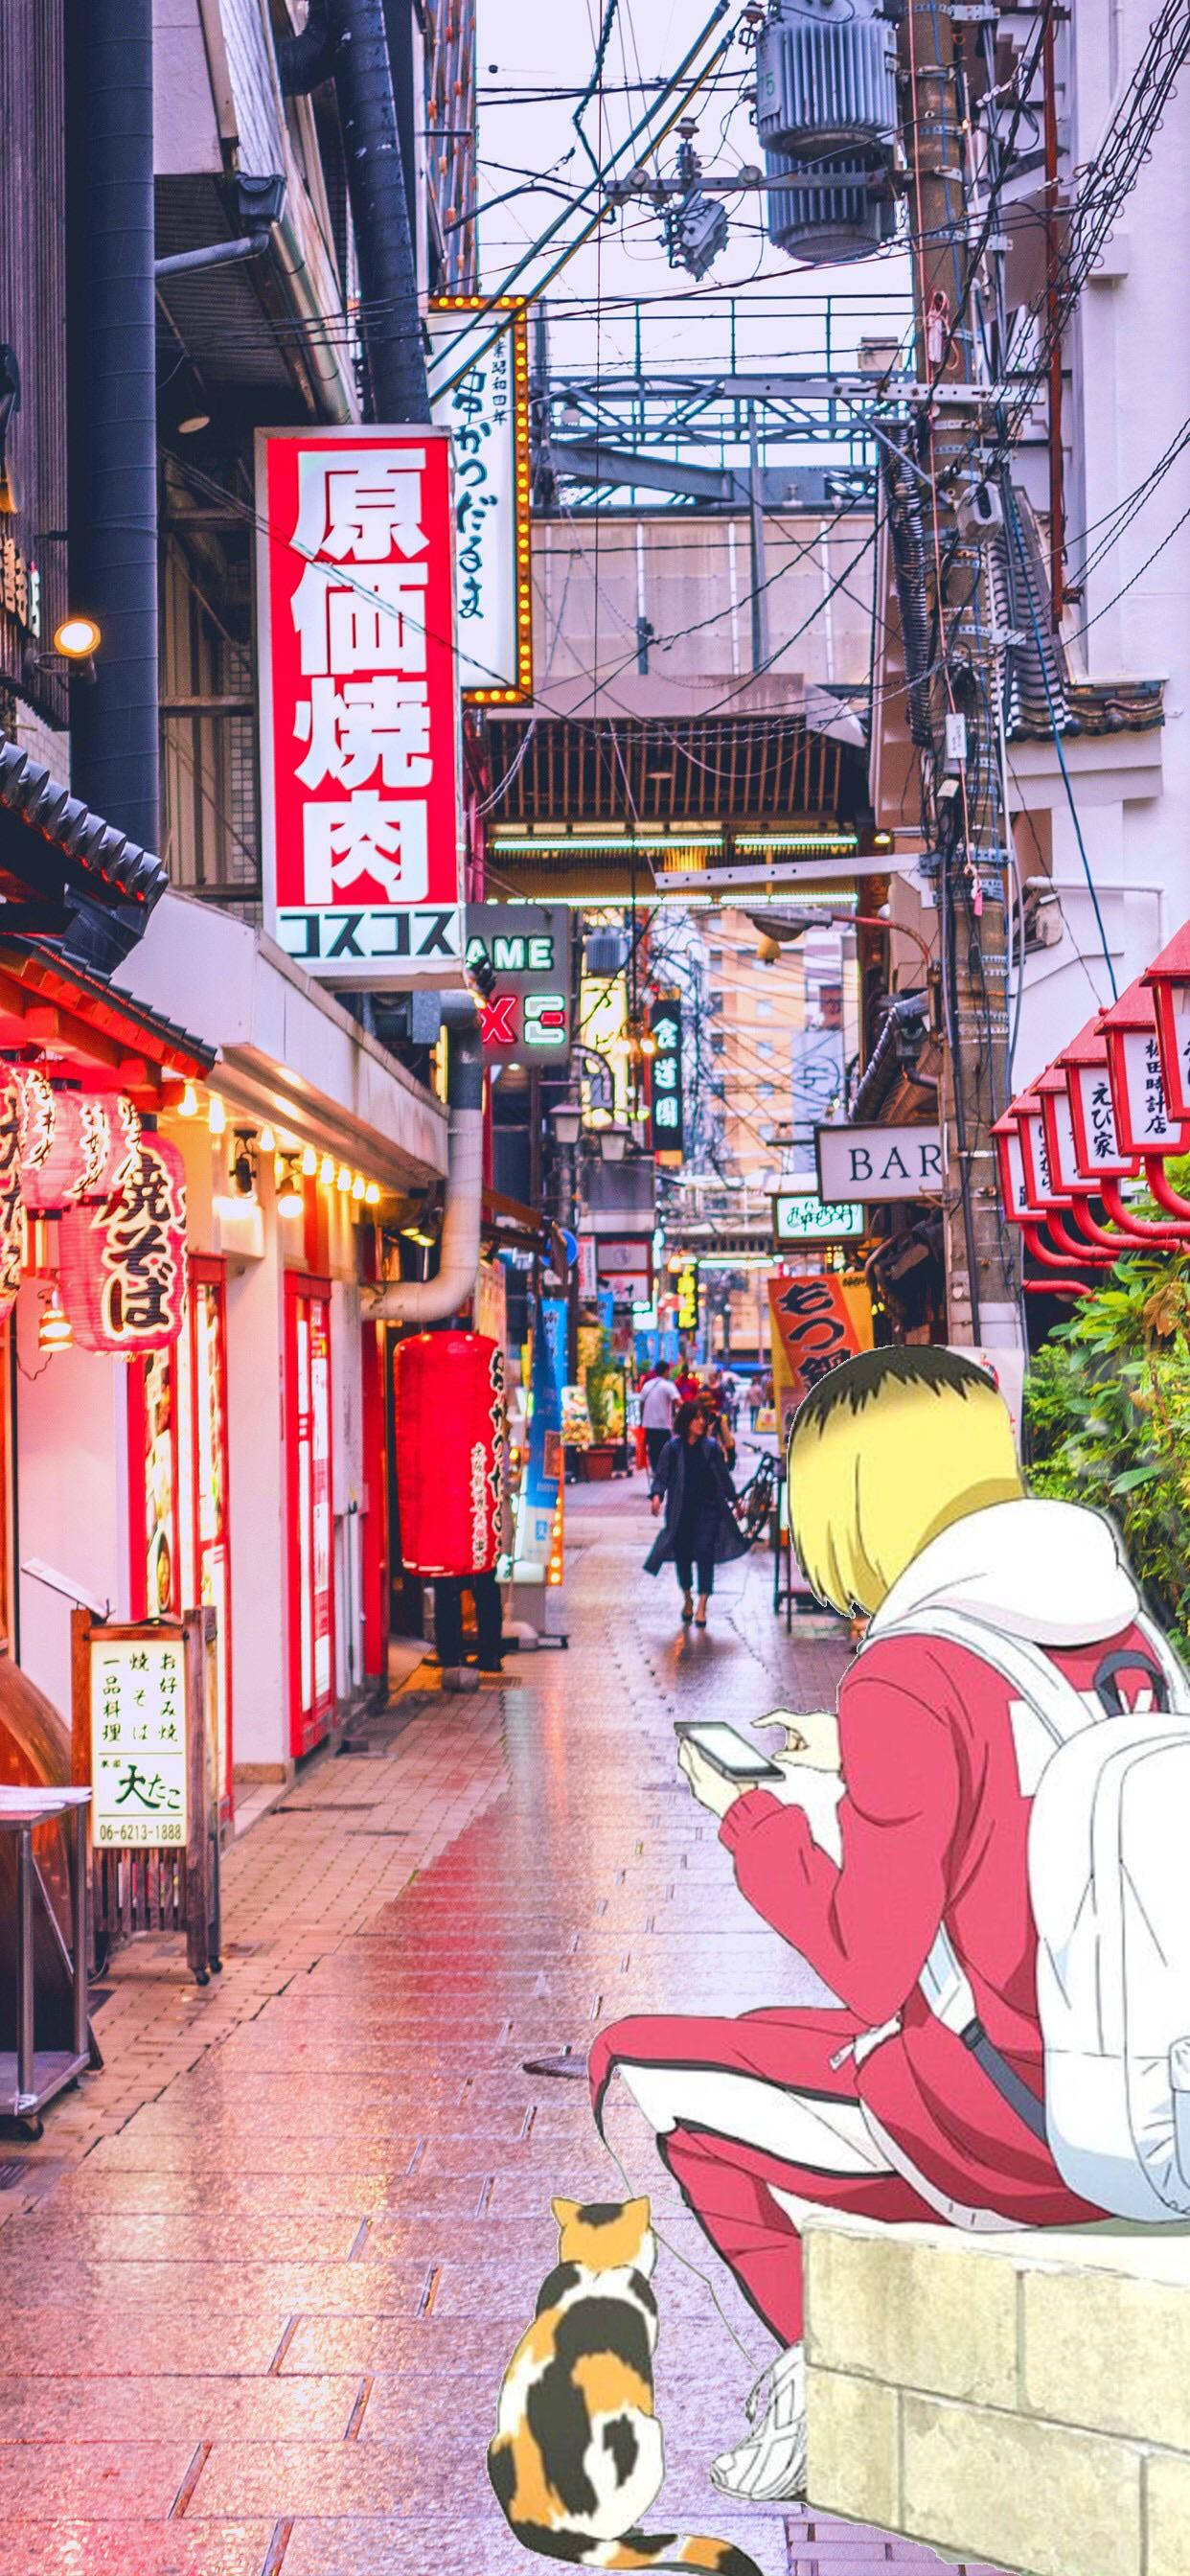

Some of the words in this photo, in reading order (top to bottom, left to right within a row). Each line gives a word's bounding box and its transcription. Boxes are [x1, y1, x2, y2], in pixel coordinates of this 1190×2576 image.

[452, 364, 497, 619] 串かつだるま
[289, 448, 434, 905] 原価焼肉
[279, 910, 457, 958] コスコス
[1091, 1082, 1116, 1158] えび家
[849, 1144, 942, 1182] BAR
[94, 1149, 173, 1336] 焼そば
[102, 1658, 122, 1742] 一品料理
[158, 1652, 178, 1742] お好み焼
[115, 1763, 181, 1809] 大たこ
[99, 1824, 182, 1841] 06-6213-1888
